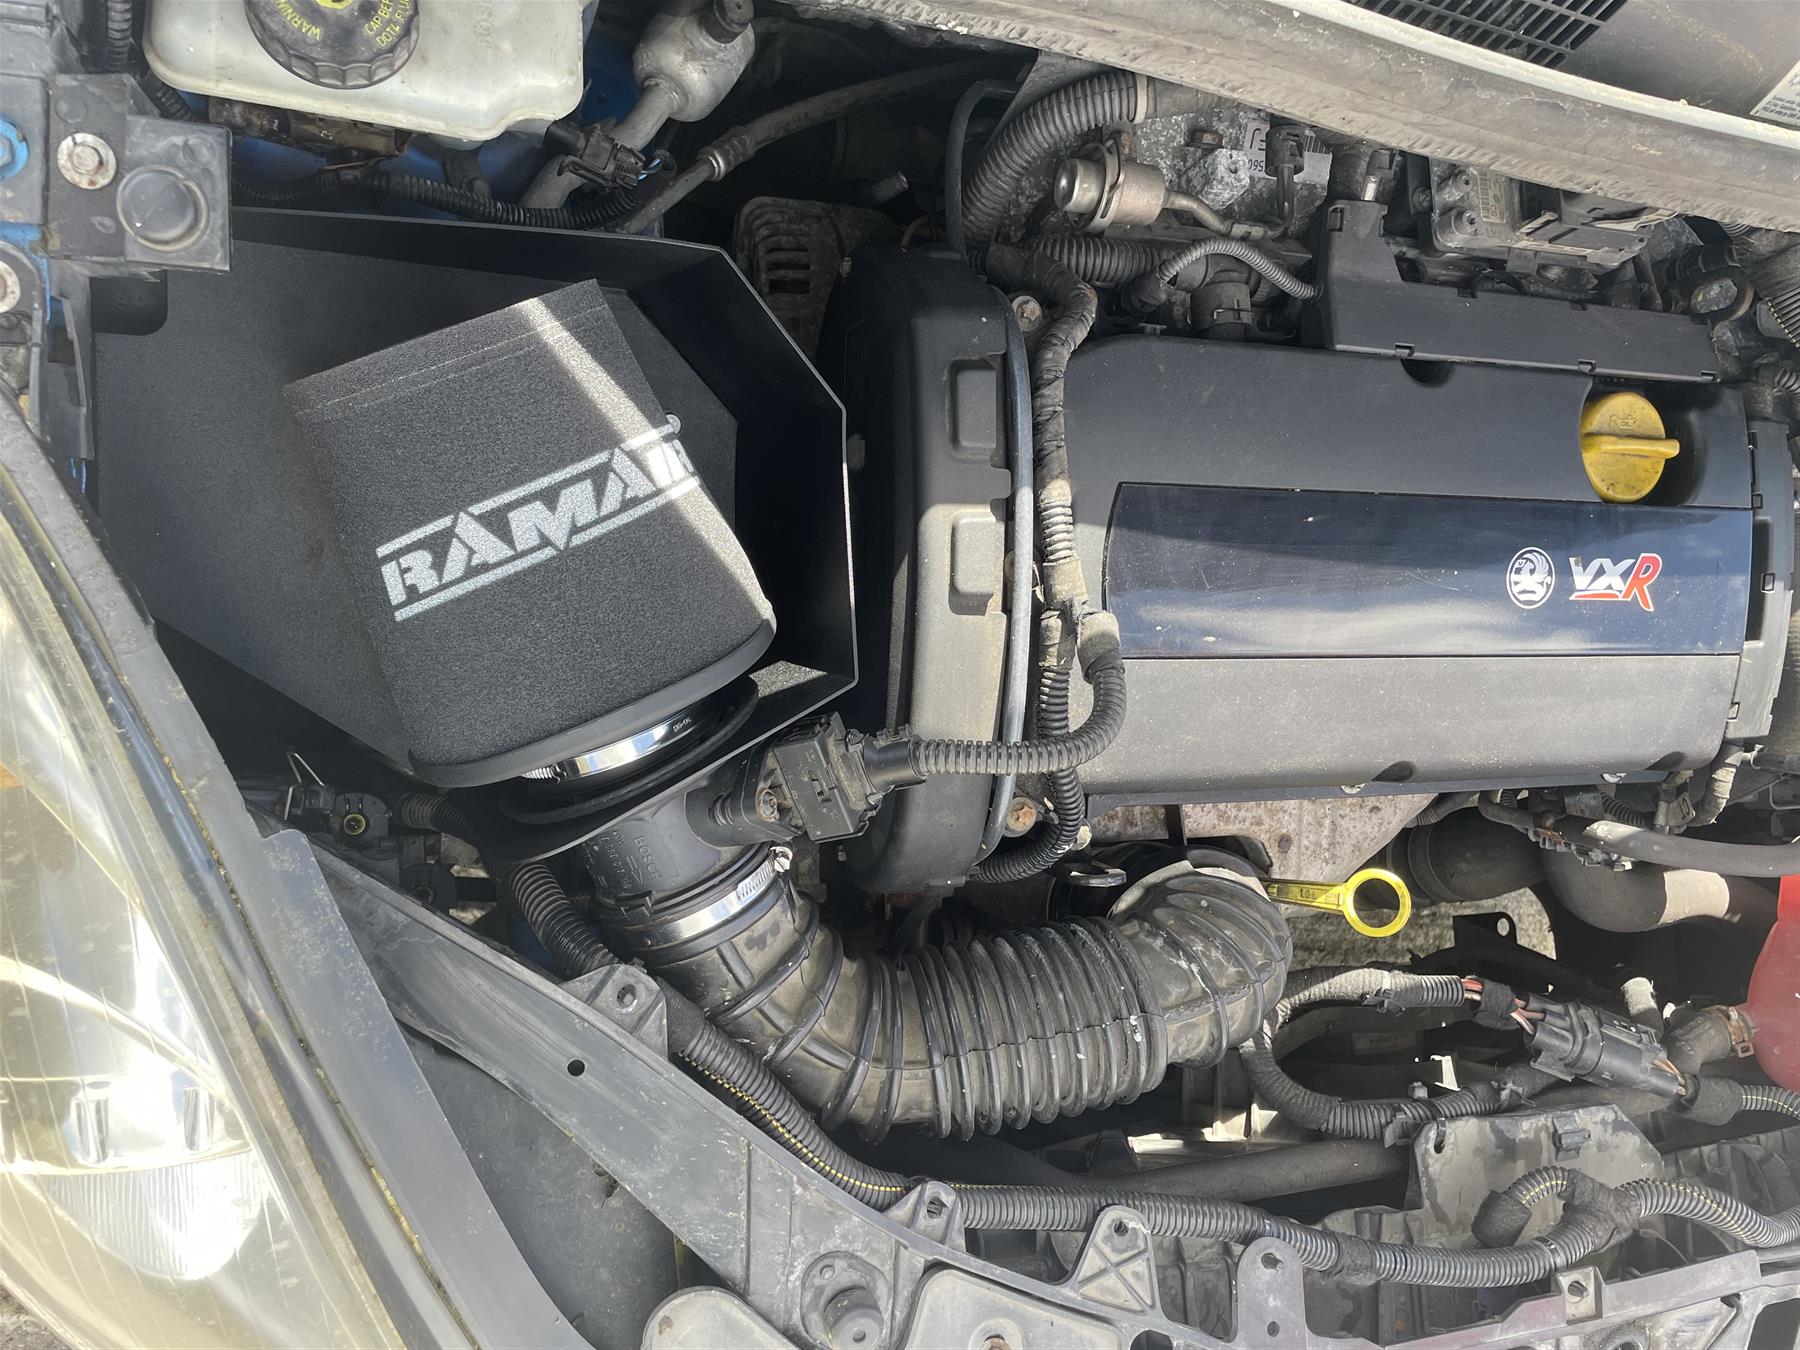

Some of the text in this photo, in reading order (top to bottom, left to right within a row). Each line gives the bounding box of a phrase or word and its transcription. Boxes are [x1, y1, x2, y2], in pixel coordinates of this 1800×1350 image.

[364, 16, 382, 34] CAP
[1568, 552, 1663, 612] VXR
[633, 835, 663, 880] BOSCH
